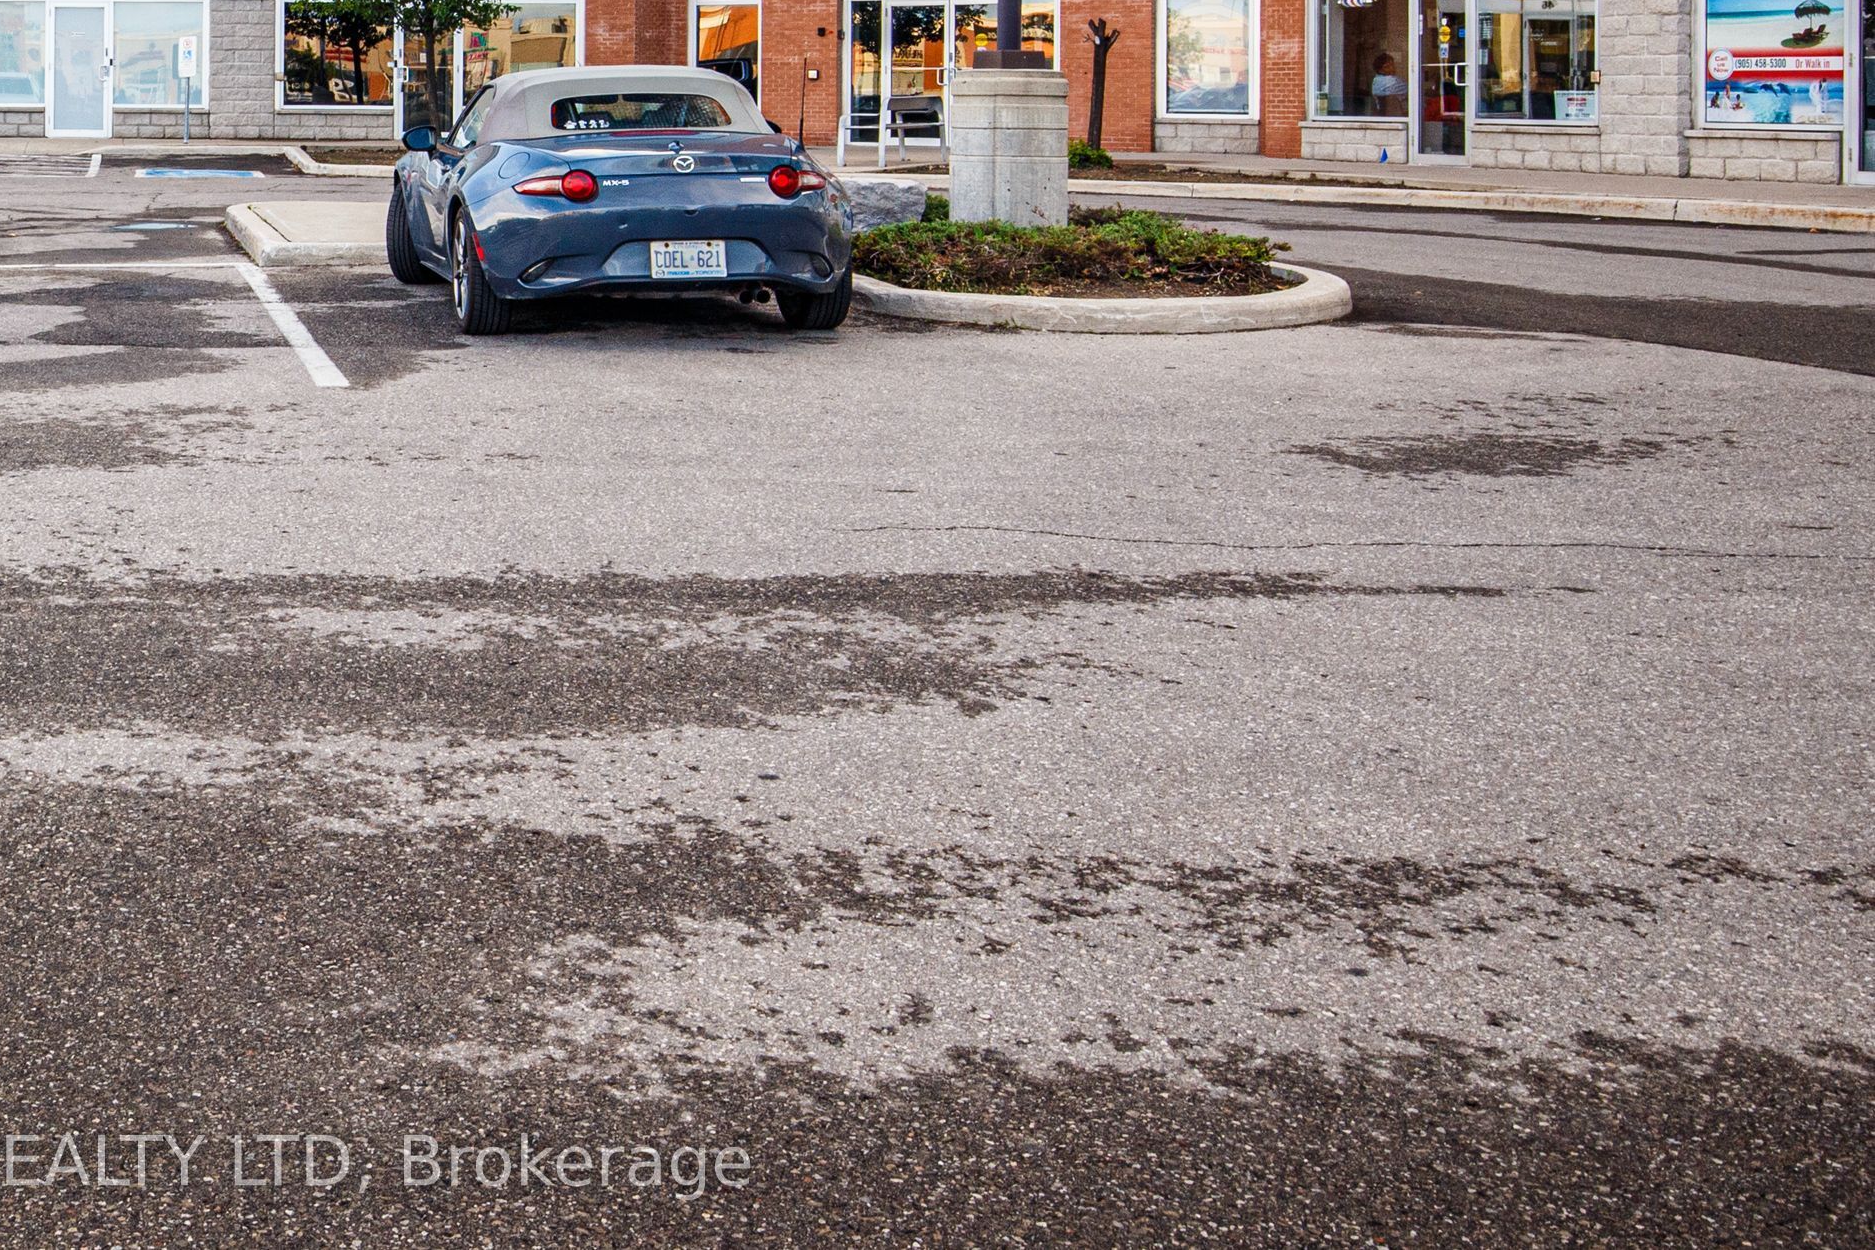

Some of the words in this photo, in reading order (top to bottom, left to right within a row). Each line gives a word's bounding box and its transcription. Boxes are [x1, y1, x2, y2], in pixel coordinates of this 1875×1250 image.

[1734, 58, 1753, 69] (905)
[1754, 58, 1787, 69] 458-5300
[1795, 59, 1804, 68] Or
[1805, 59, 1821, 68] Walk
[1823, 58, 1830, 68] in
[602, 179, 630, 187] MX-5
[654, 250, 689, 268] CDEL
[697, 250, 722, 268] 621
